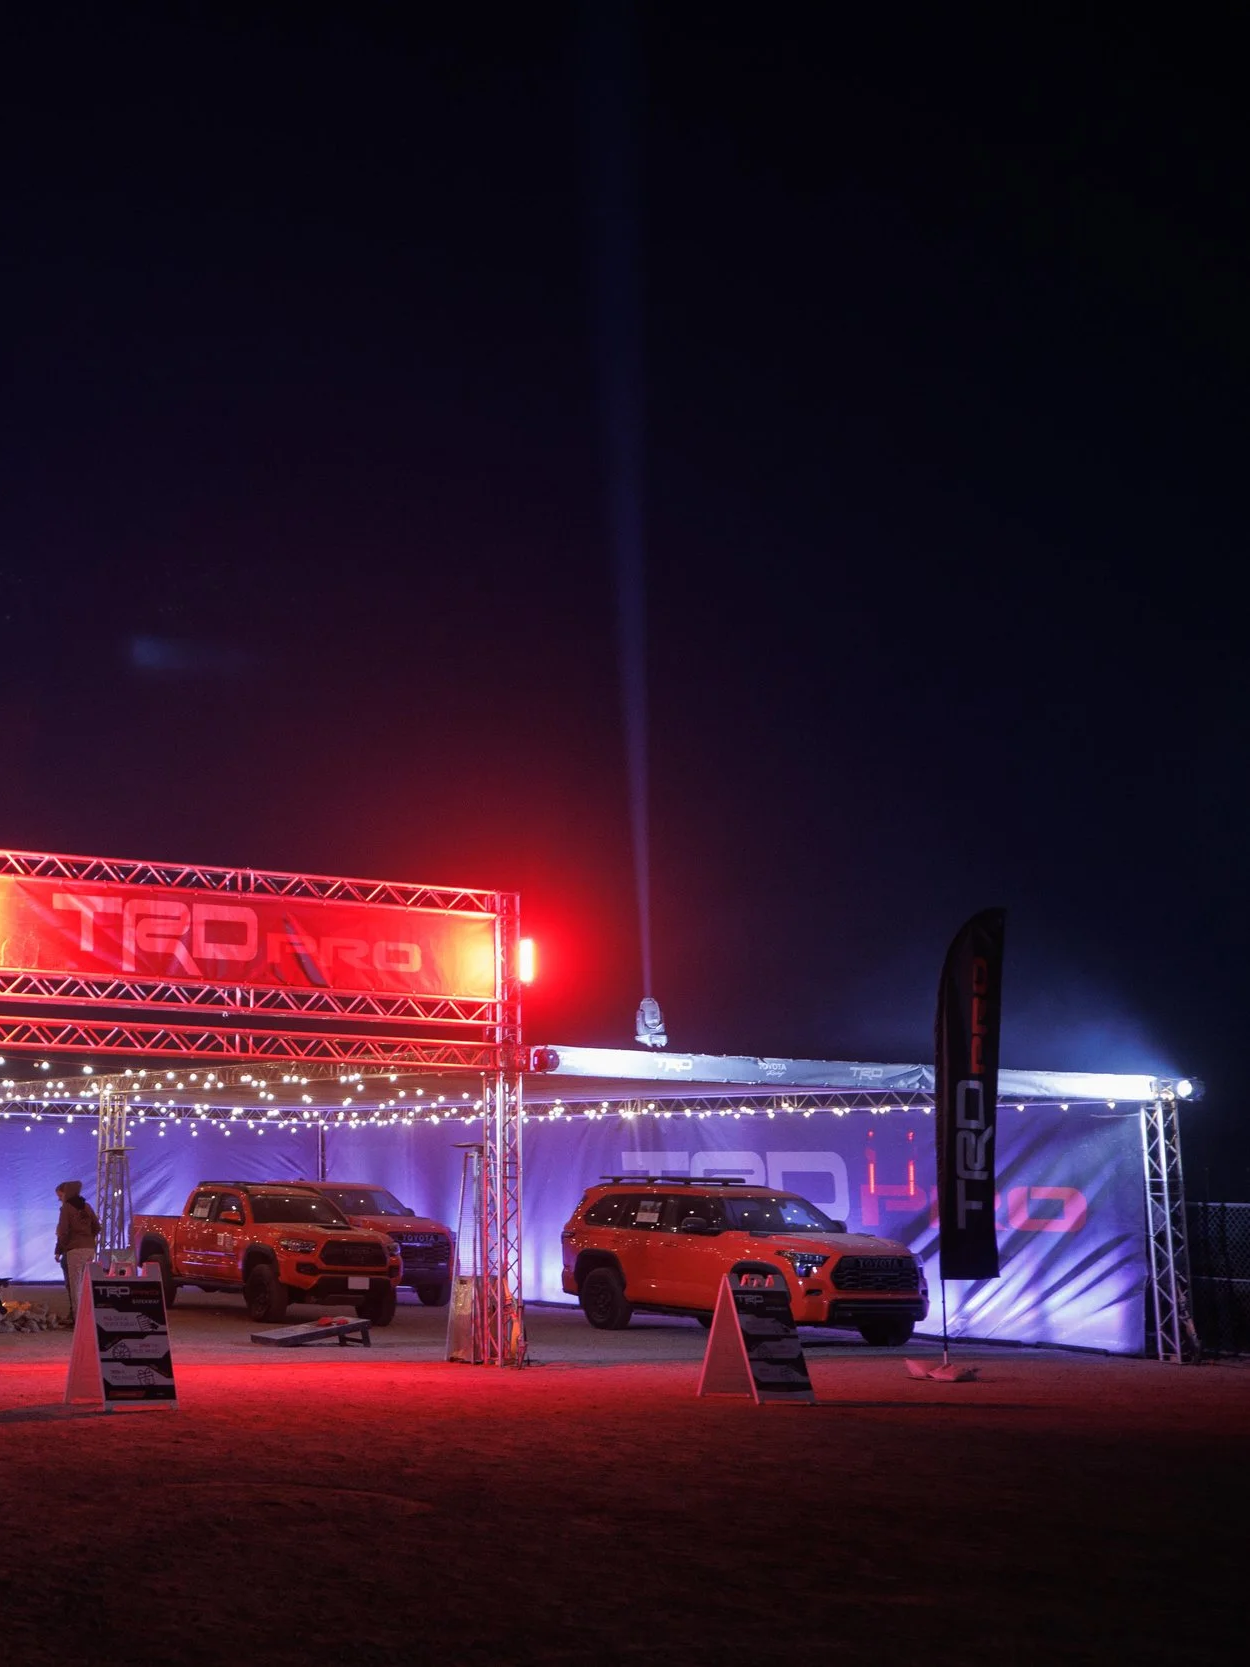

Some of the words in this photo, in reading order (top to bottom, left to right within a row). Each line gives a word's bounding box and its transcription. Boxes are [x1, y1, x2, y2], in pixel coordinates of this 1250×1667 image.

[52, 893, 258, 976] TRD
[267, 930, 422, 973] PRO
[654, 1057, 693, 1073] TRD
[758, 1062, 787, 1071] TOYOTA
[850, 1066, 883, 1081] TRD
[955, 1079, 994, 1230] TRD
[402, 1233, 435, 1242] TOYOTA
[94, 1286, 131, 1298] TRD
[735, 1295, 765, 1305] TRD
